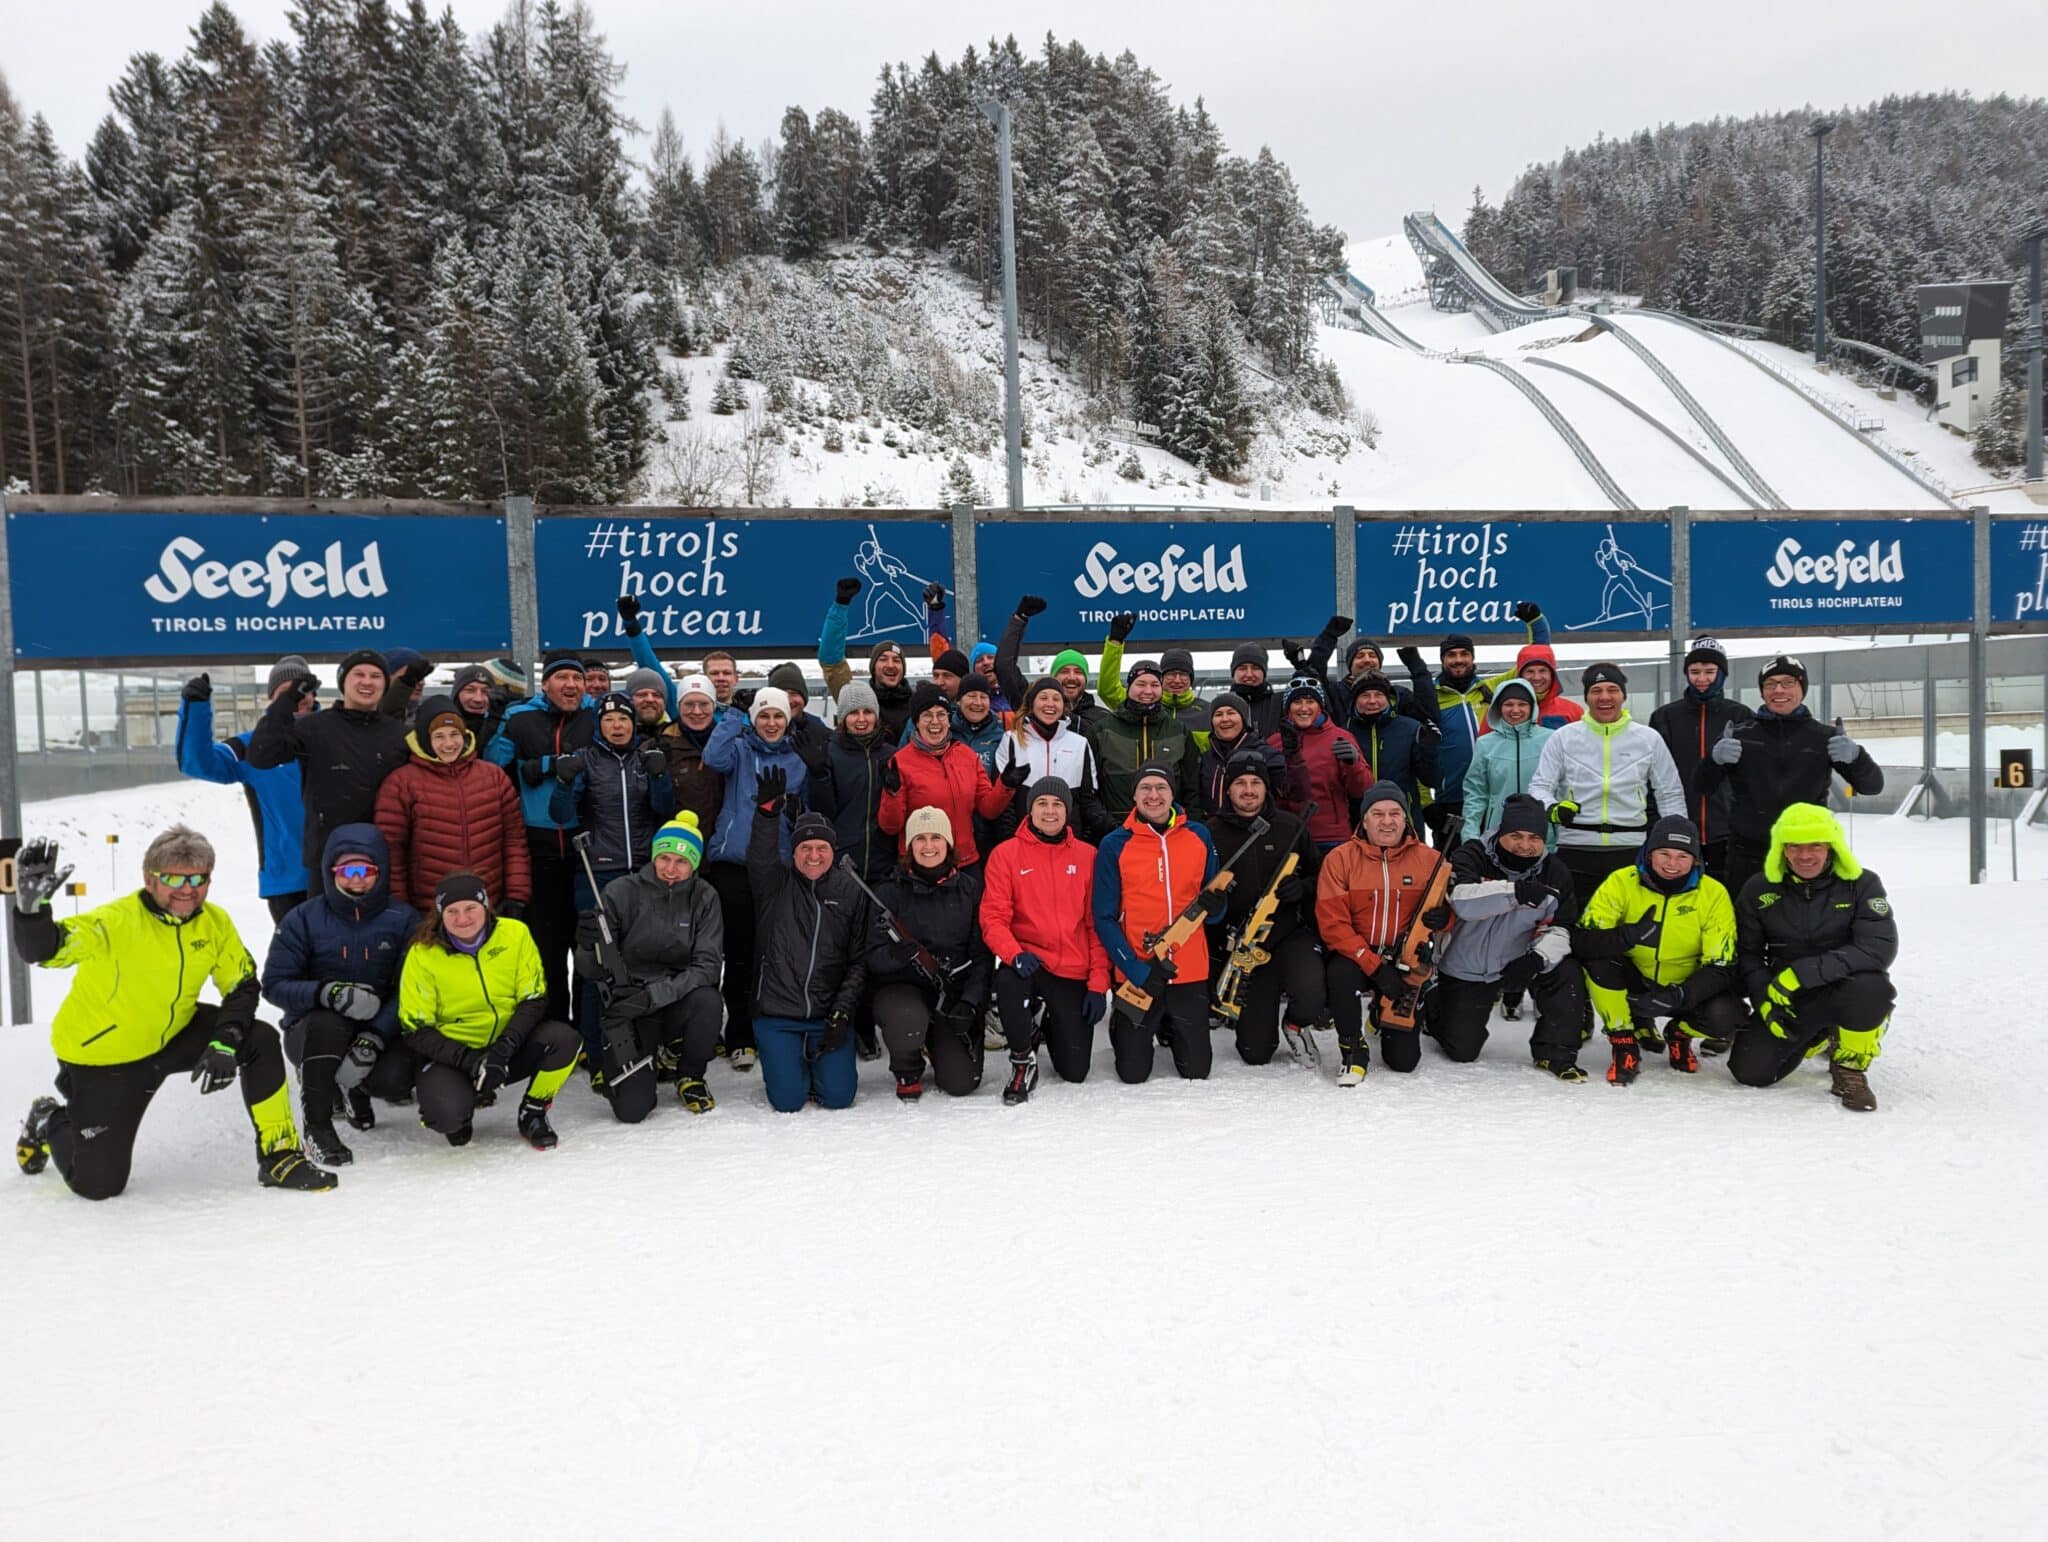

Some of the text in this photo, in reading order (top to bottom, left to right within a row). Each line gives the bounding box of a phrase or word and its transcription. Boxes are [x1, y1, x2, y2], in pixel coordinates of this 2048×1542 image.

[584, 521, 739, 559] #tirols
[1391, 523, 1509, 557] #tirols
[143, 536, 389, 608] Seefeld
[619, 556, 728, 597] hoch
[1073, 541, 1248, 602] Seefeld
[1417, 556, 1499, 589] hoch
[1766, 537, 1905, 591] Seefeld
[1139, 608, 1245, 621] HOCHPLATEAU
[1770, 596, 1903, 609] TIROLS HOCHPLATEAU
[151, 616, 386, 632] TIROLS HOCHPLATEAU
[2009, 762, 2025, 787] 6
